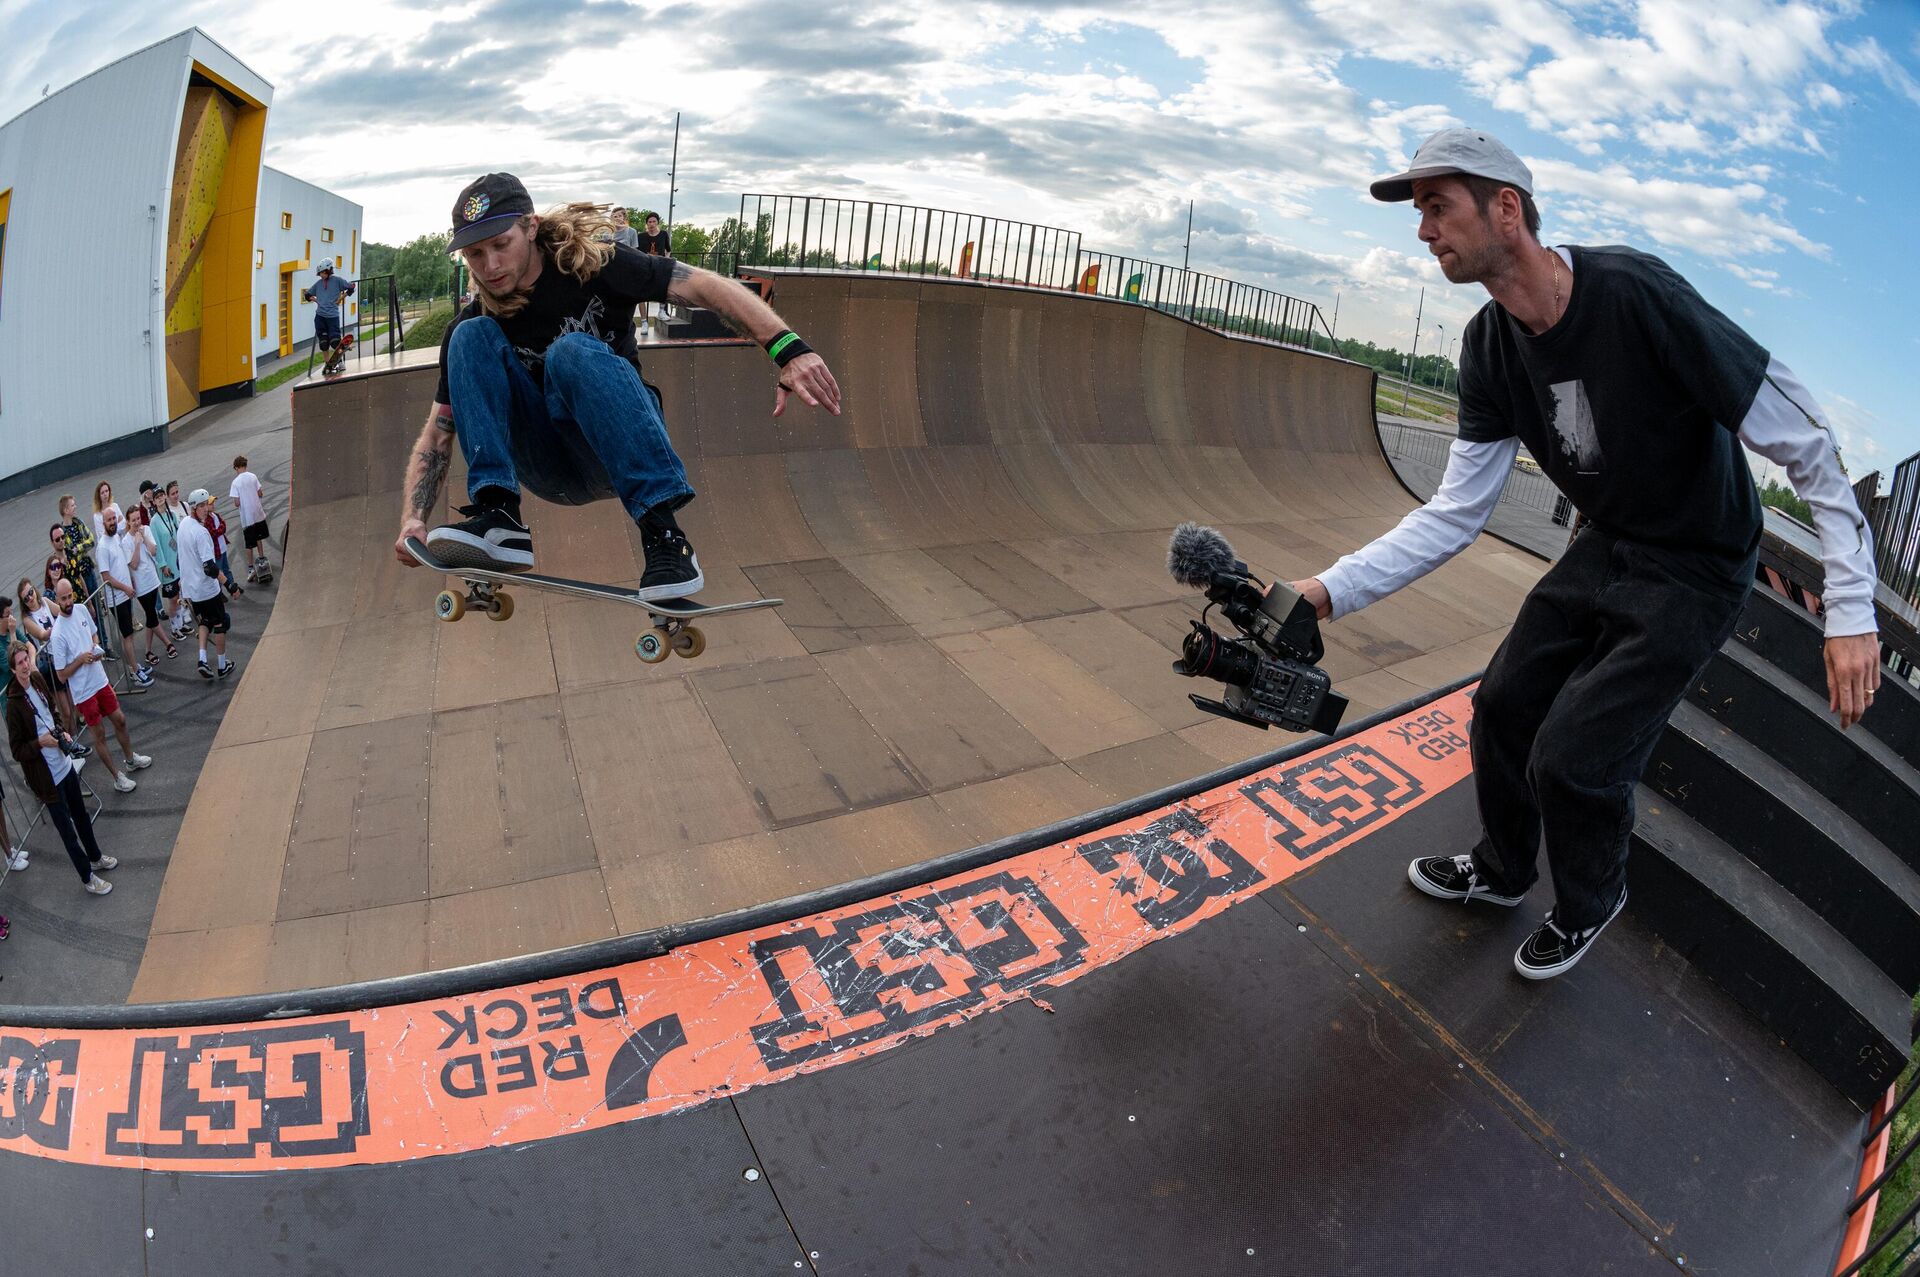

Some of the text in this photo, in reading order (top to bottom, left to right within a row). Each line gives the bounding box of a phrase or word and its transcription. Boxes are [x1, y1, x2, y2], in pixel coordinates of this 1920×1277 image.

[1305, 670, 1327, 683] SONY
[1387, 710, 1456, 746] DECK
[1417, 731, 1468, 761] RED
[1238, 742, 1426, 861] GST
[749, 870, 1091, 1073] GST
[432, 977, 628, 1050] DECK
[105, 1019, 371, 1159] GST
[440, 1034, 590, 1099] RED
